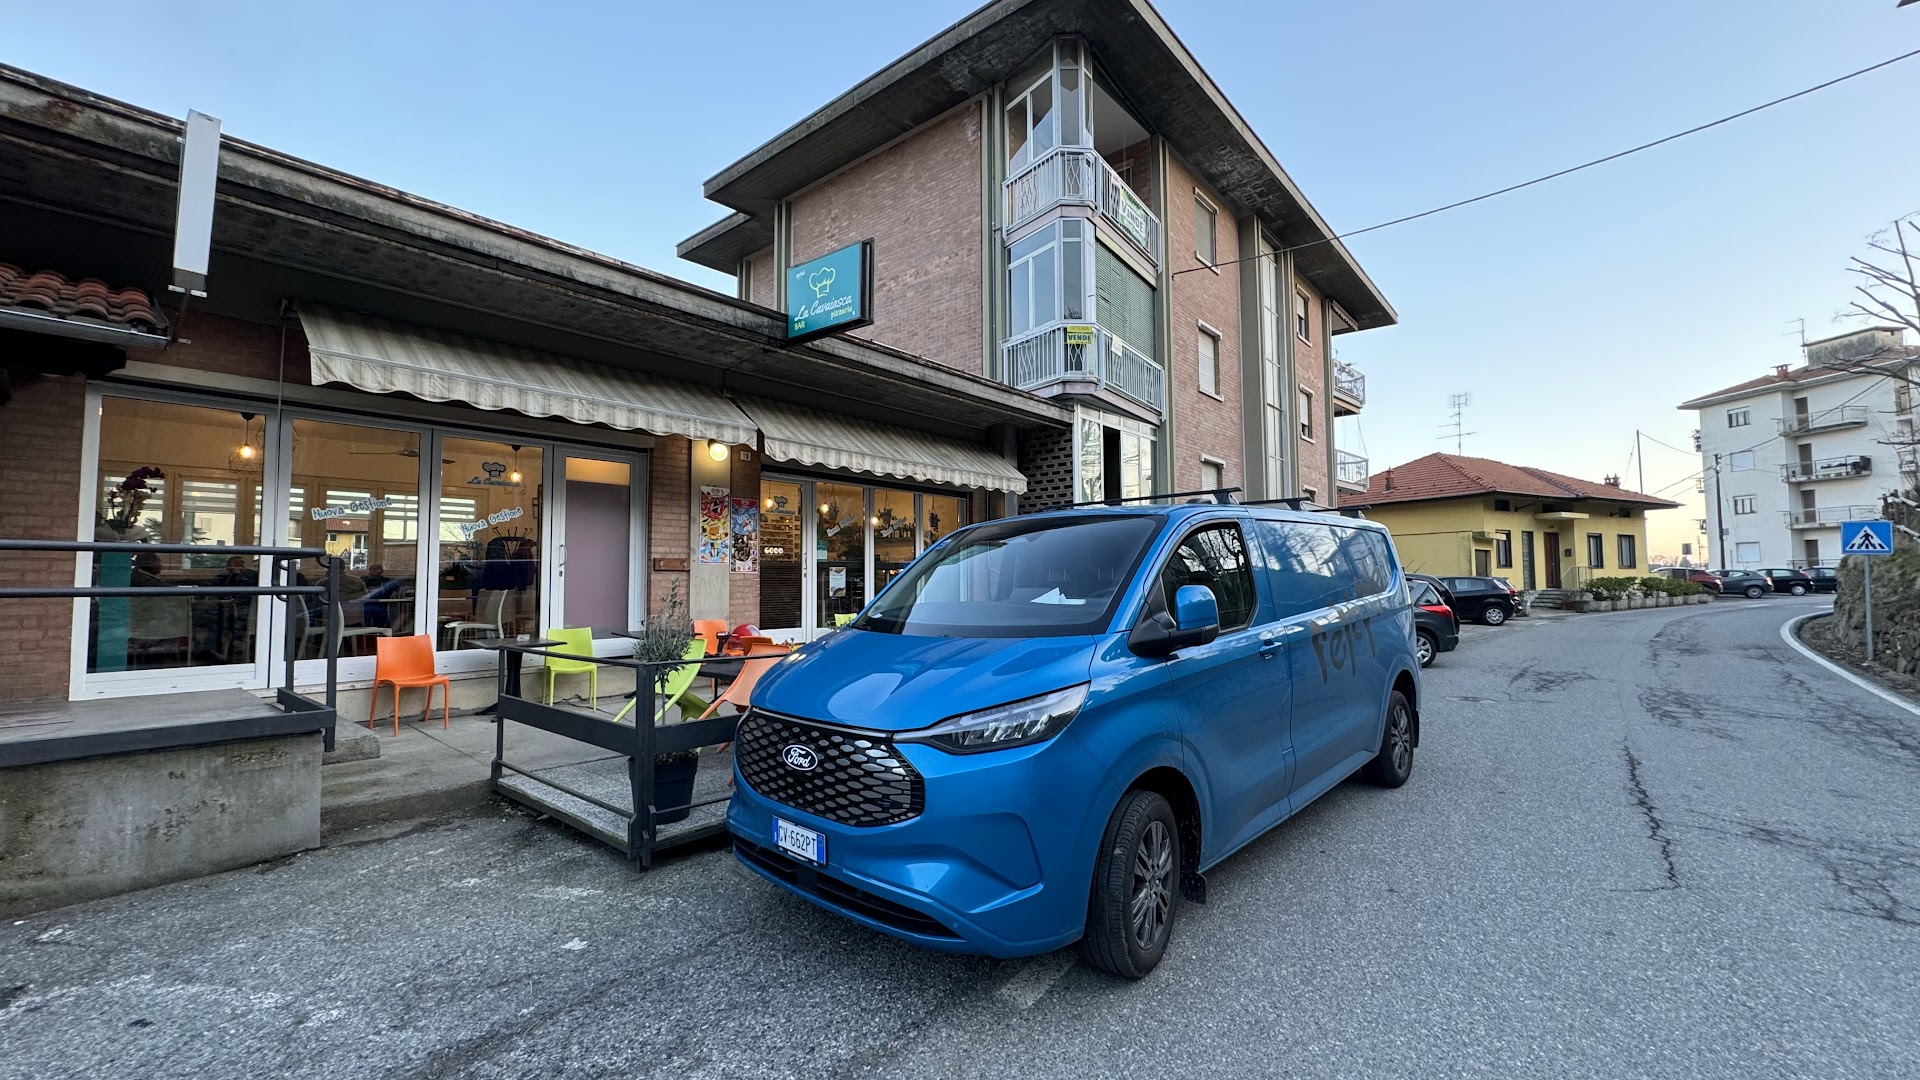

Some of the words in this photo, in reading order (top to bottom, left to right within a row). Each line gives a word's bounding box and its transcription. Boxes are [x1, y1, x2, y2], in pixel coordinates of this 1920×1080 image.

[794, 304, 809, 321] La
[830, 305, 853, 320] pizzeria
[794, 320, 806, 331] BAR
[312, 506, 345, 520] Nuova
[349, 496, 393, 513] Gestione
[461, 519, 488, 534] Nuova
[489, 507, 523, 524] Gestione
[787, 747, 812, 768] Ford
